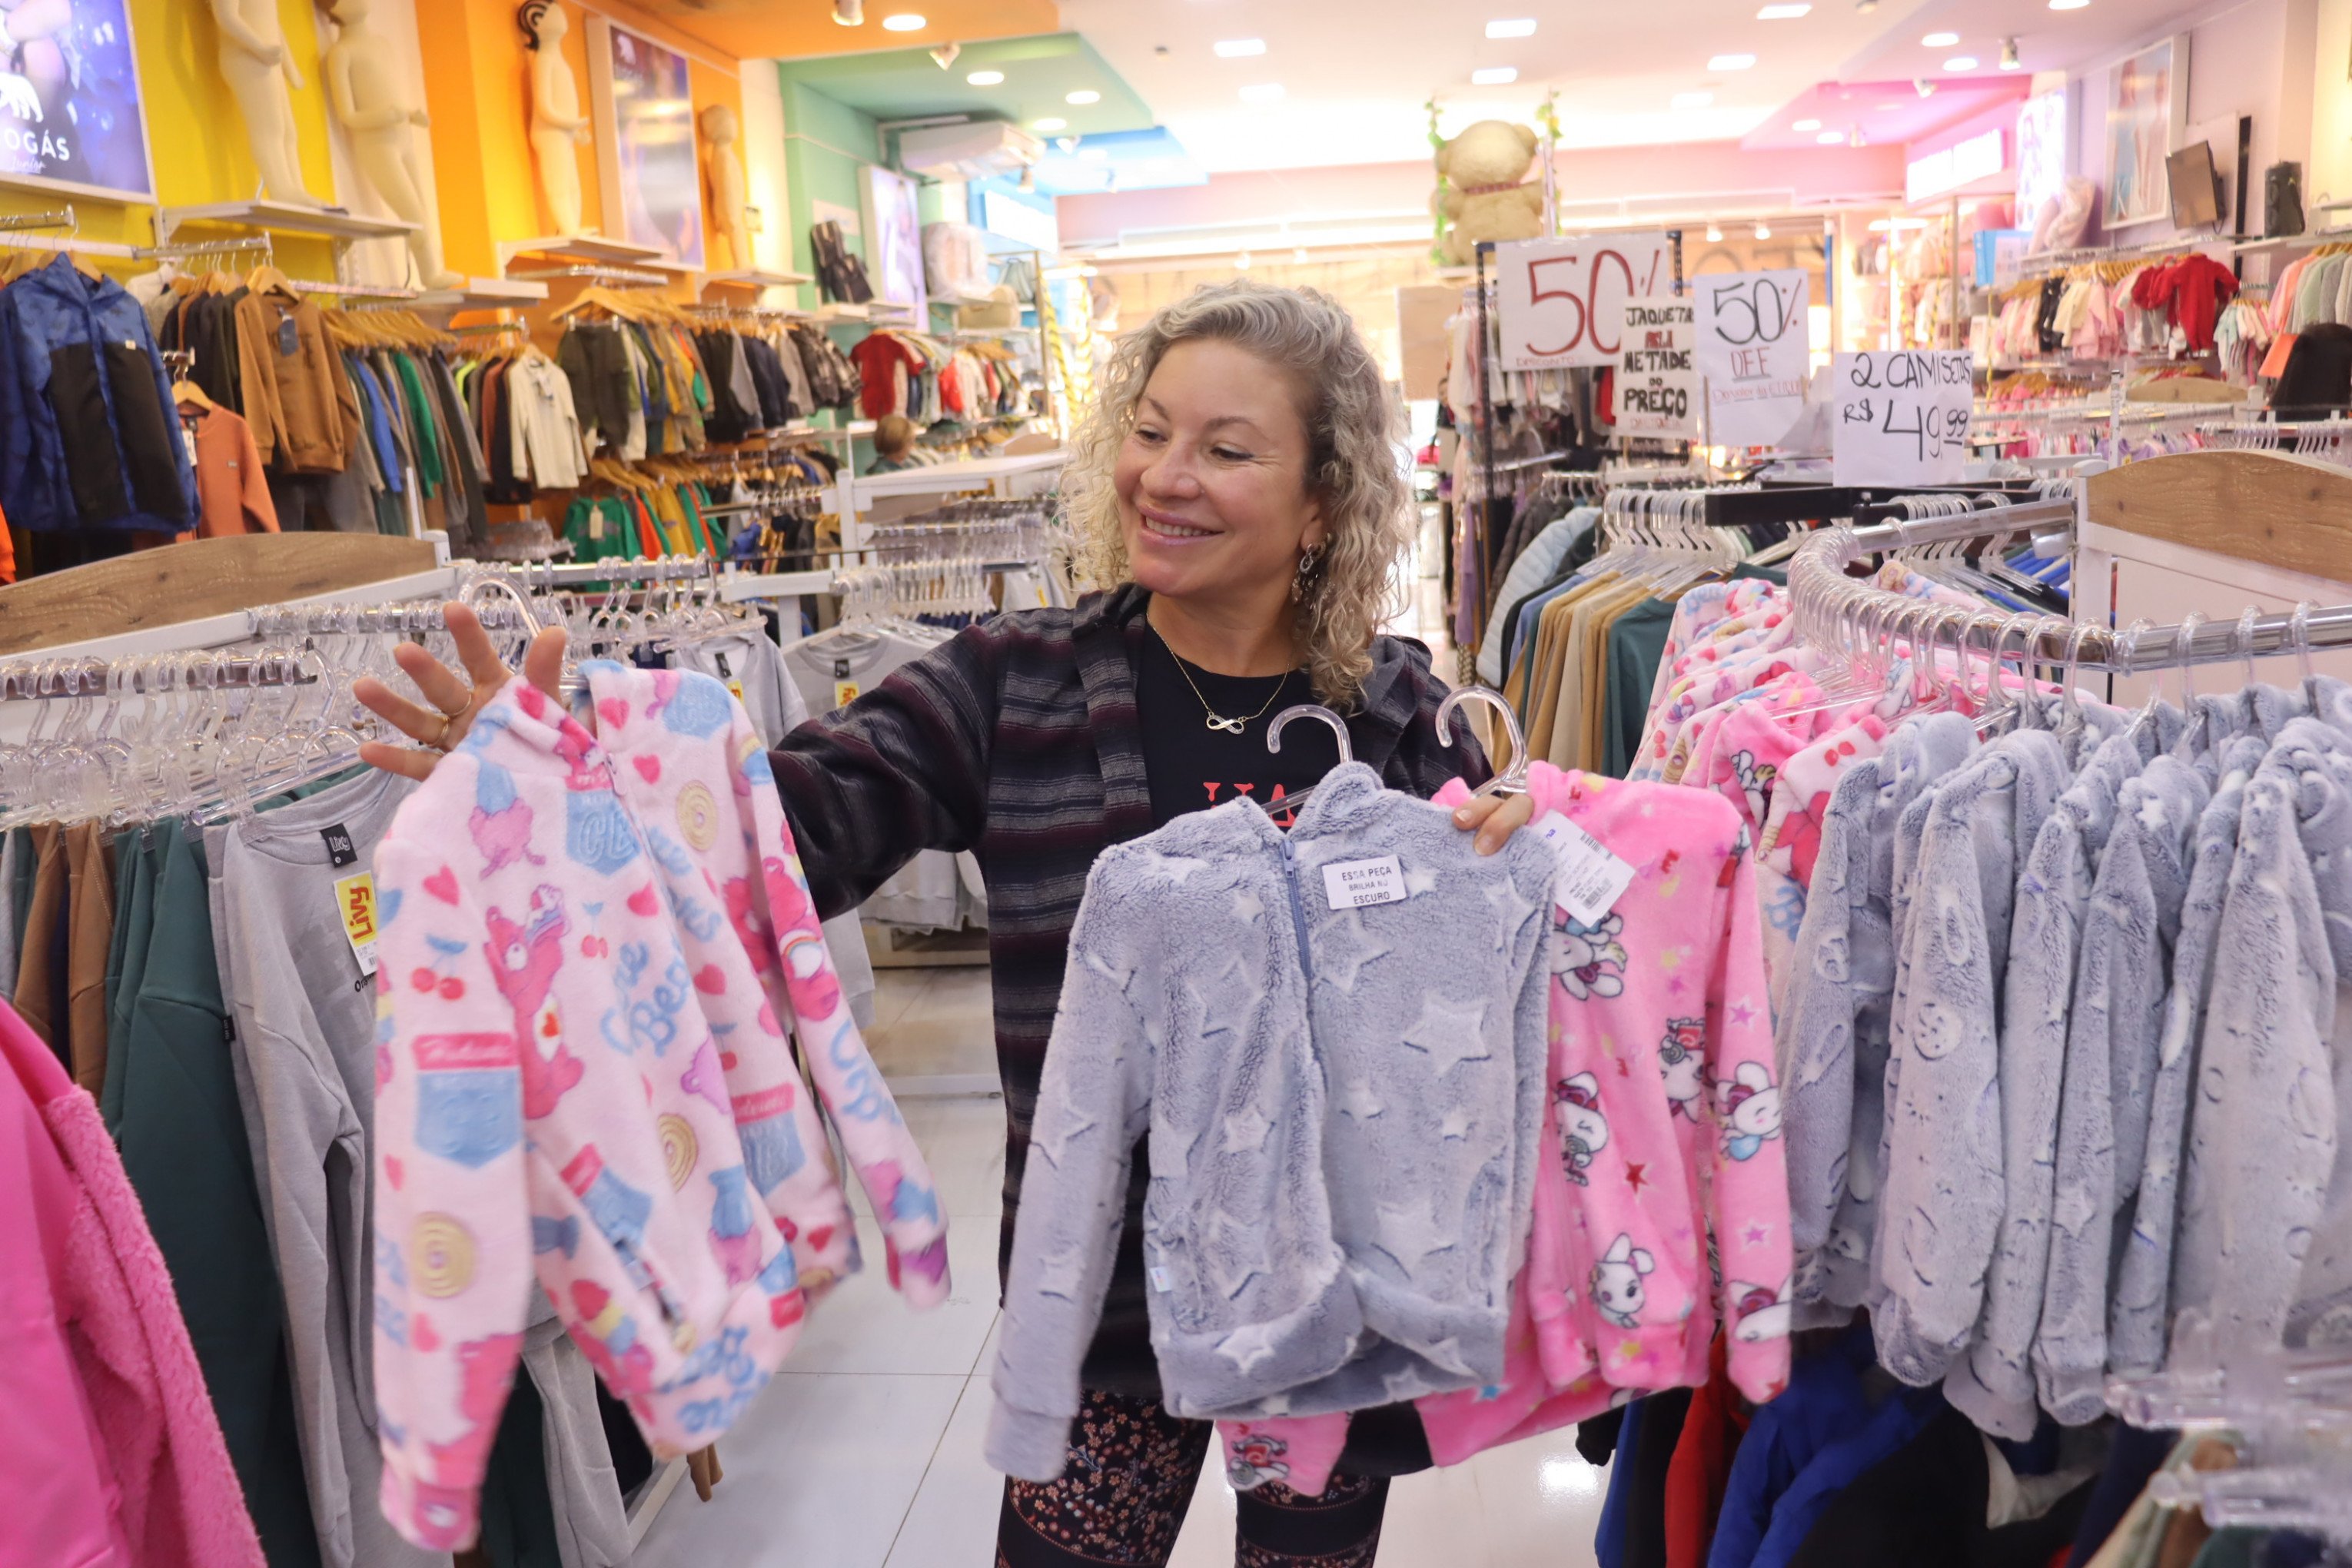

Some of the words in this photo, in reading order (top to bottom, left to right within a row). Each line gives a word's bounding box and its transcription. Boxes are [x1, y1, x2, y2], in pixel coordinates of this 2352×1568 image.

[1713, 278, 1802, 345] 50%
[1623, 350, 1692, 373] METADE
[1730, 347, 1770, 377] OFF
[1851, 352, 1882, 389] 2
[1886, 352, 1971, 389] CAMISETAS
[1624, 387, 1687, 420] PREÇO
[1843, 398, 1874, 424] R$
[1349, 881, 1376, 892] BRILHA
[1354, 891, 1390, 905] ESCURO
[349, 886, 374, 940] Livy
